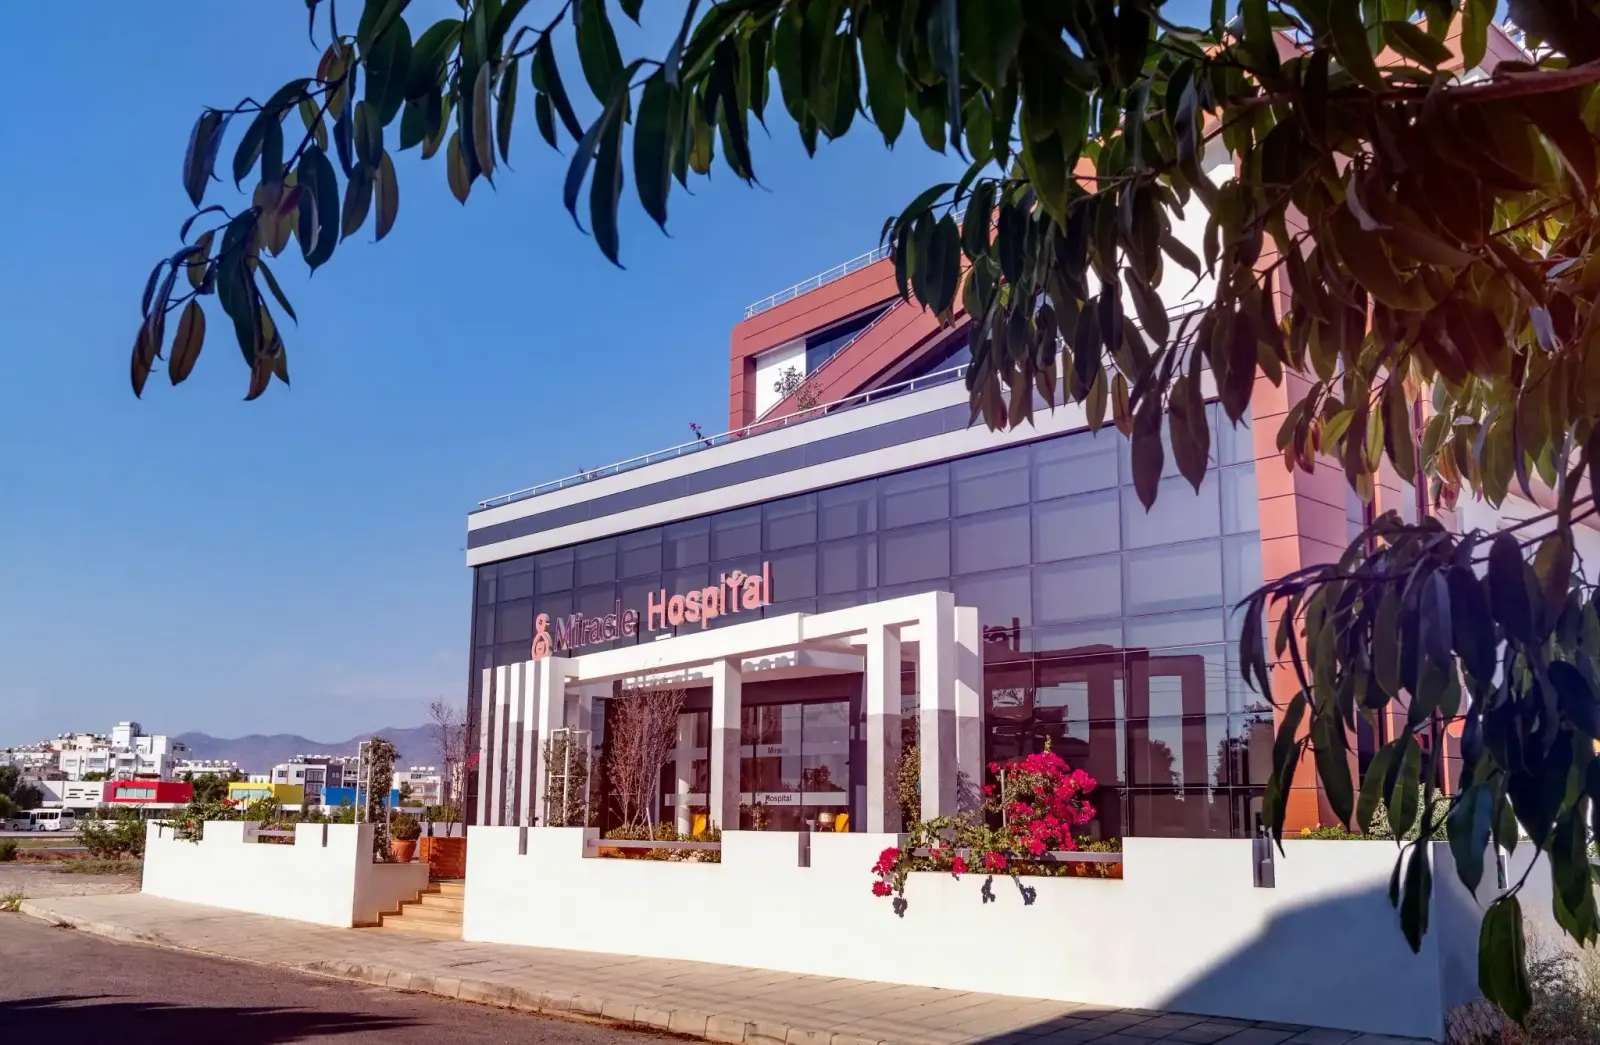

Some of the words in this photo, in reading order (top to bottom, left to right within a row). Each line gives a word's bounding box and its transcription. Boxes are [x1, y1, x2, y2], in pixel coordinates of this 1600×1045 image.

[553, 599, 638, 652] Miracle
[647, 561, 773, 631] Hospital
[767, 746, 789, 754] Mira
